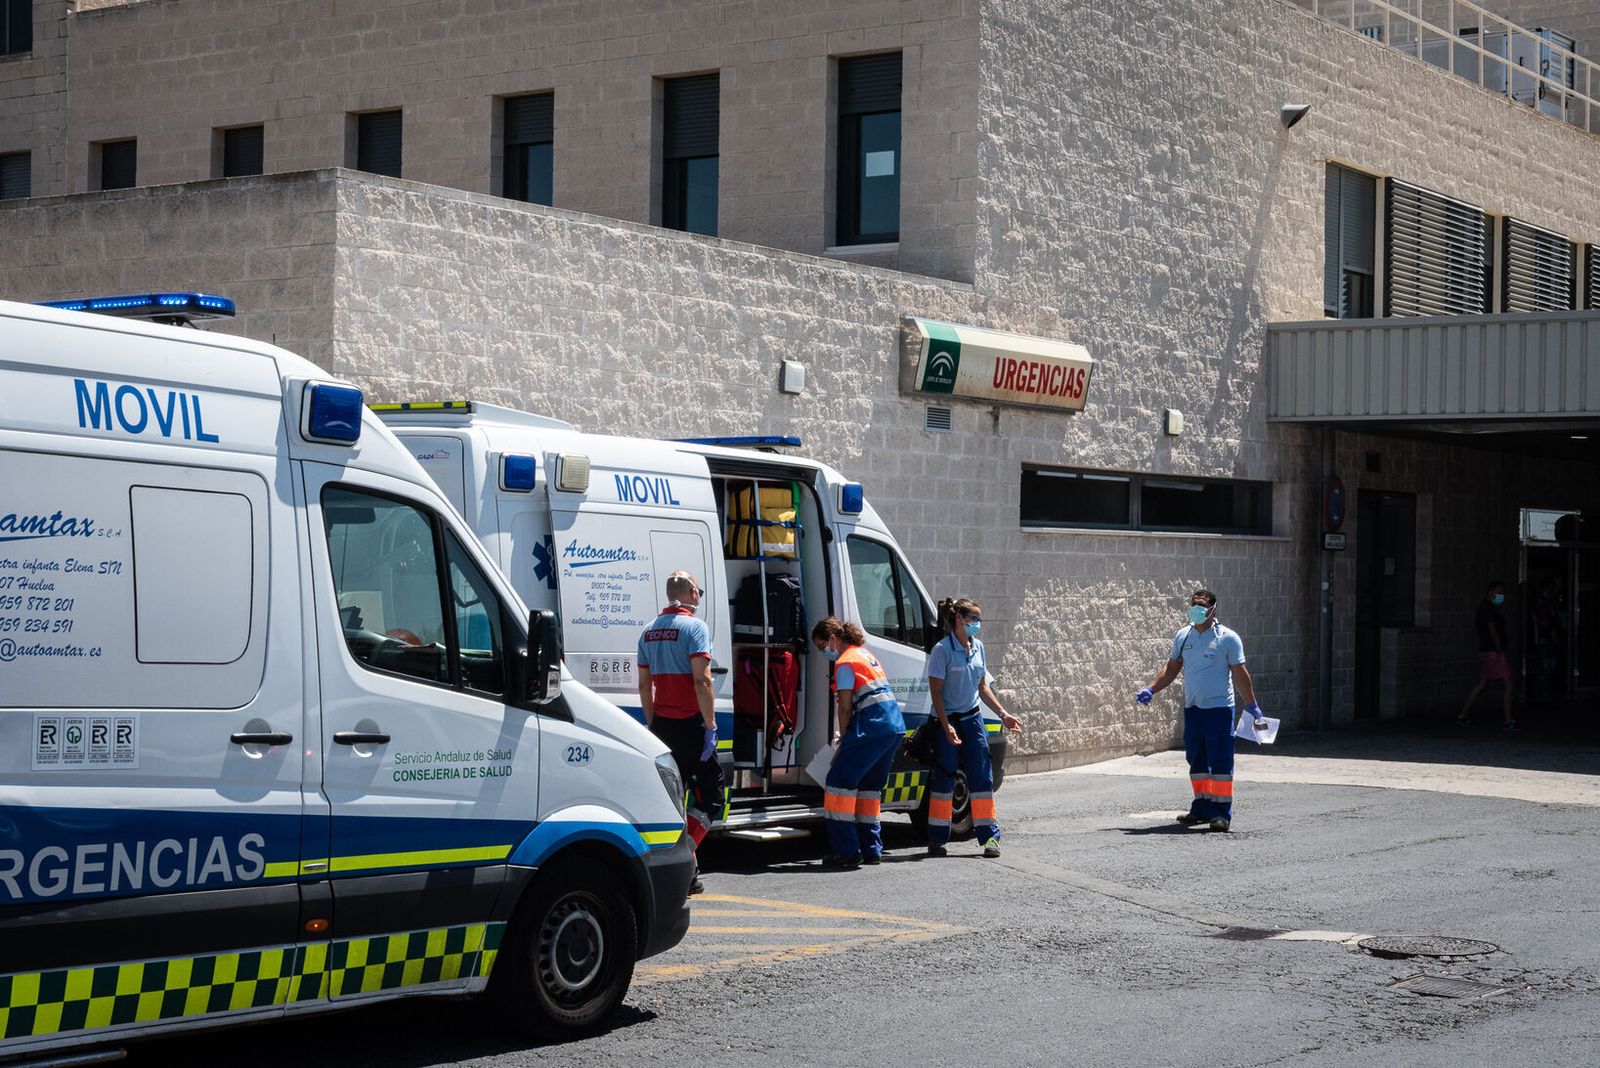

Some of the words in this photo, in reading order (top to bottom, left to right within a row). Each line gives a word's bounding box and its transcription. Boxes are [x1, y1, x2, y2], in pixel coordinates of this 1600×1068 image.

[993, 357, 1085, 399] URGENCIAS
[74, 378, 220, 443] MOVIL
[614, 474, 681, 506] MOVIL
[563, 539, 636, 561] Autoamtax
[22, 558, 60, 575] infanta
[64, 558, 94, 573] Elena
[98, 560, 122, 575] S/N
[16, 576, 55, 591] Huelva
[27, 596, 50, 611] 872
[54, 598, 74, 612] 201
[24, 619, 50, 632] 234
[52, 619, 74, 633] 591
[394, 752, 432, 764] Servicio
[434, 751, 471, 763] Andaluz
[473, 750, 484, 761] de
[487, 748, 512, 760] Salud
[567, 747, 589, 762] 234
[393, 767, 460, 782] CONSEJERIA
[463, 767, 477, 778] DE
[479, 765, 513, 778] SALUD
[0, 832, 266, 900] RGENCIAS
